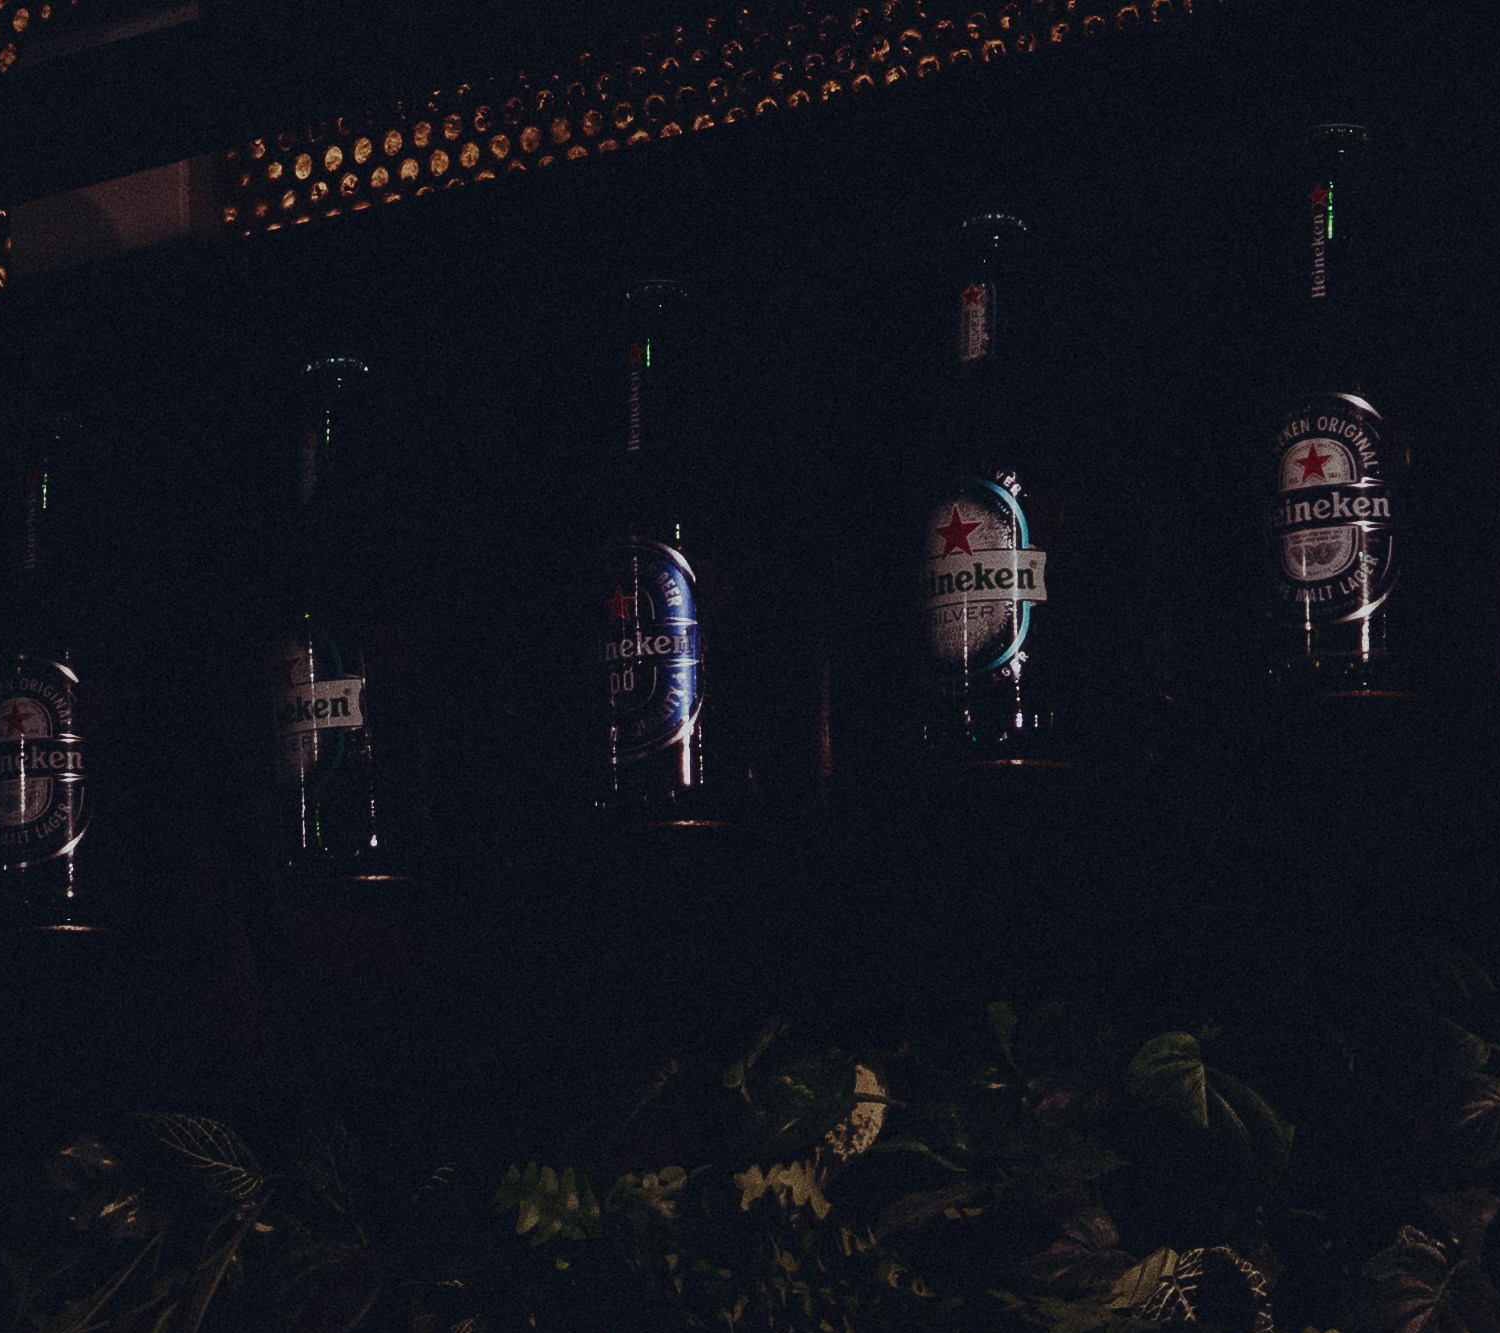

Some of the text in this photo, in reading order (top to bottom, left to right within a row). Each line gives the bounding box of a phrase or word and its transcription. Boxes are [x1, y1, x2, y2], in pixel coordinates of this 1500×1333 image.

[1311, 213, 1325, 299] Heineken
[1317, 416, 1379, 469] ORIGINAL
[1276, 491, 1391, 526] eineken
[605, 630, 693, 661] neken
